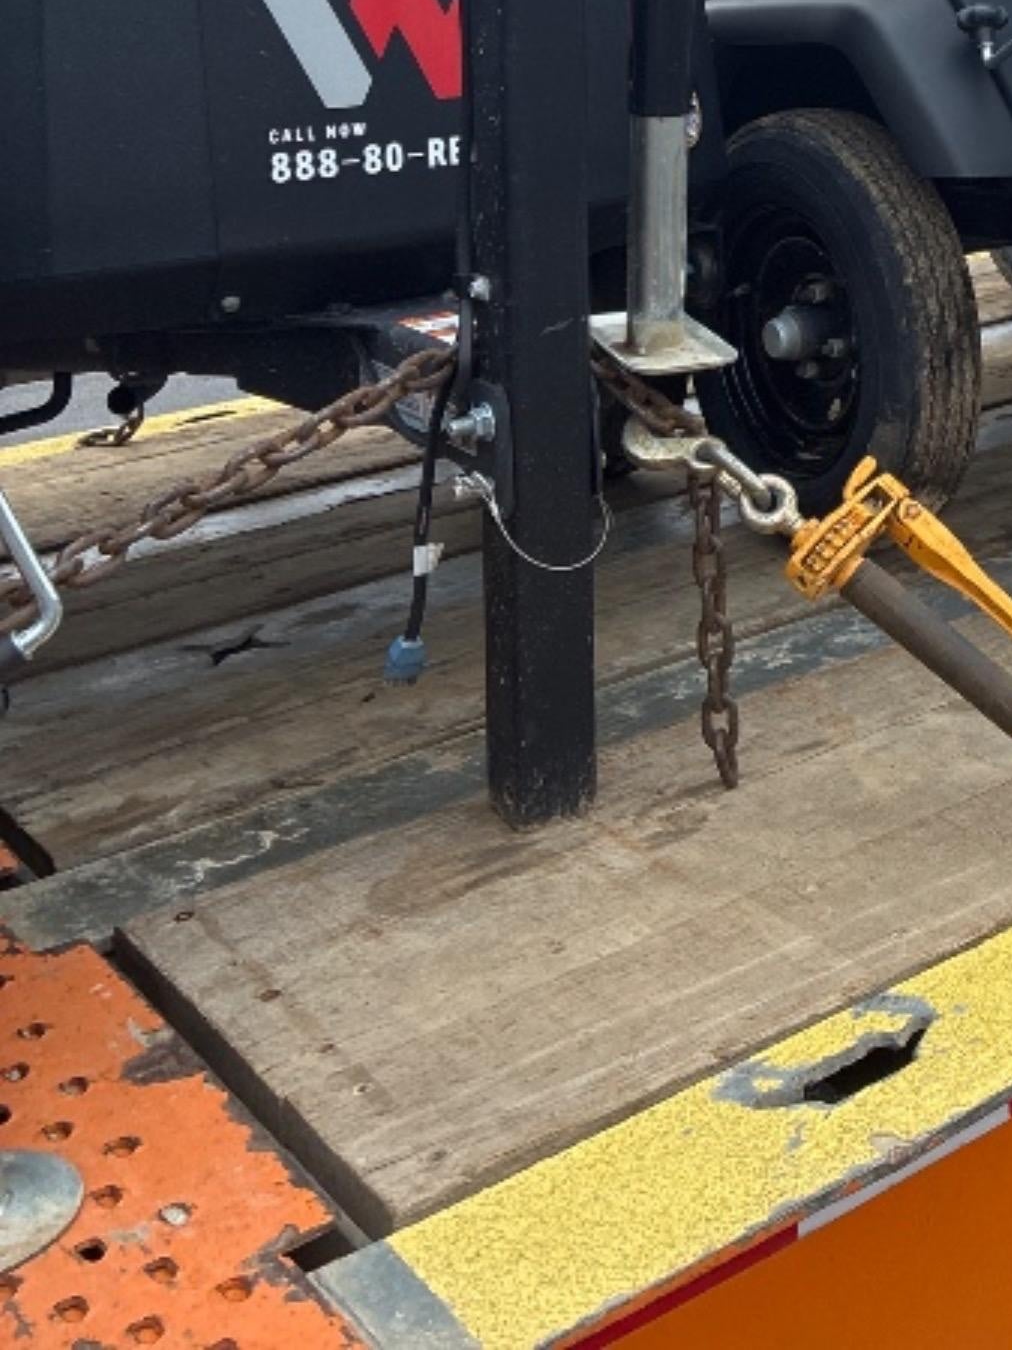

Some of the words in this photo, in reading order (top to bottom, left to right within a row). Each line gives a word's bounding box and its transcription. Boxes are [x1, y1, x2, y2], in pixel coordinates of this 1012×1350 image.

[268, 126, 316, 145] CALL
[325, 122, 367, 140] NOW
[270, 134, 462, 184] 888-80-RE
